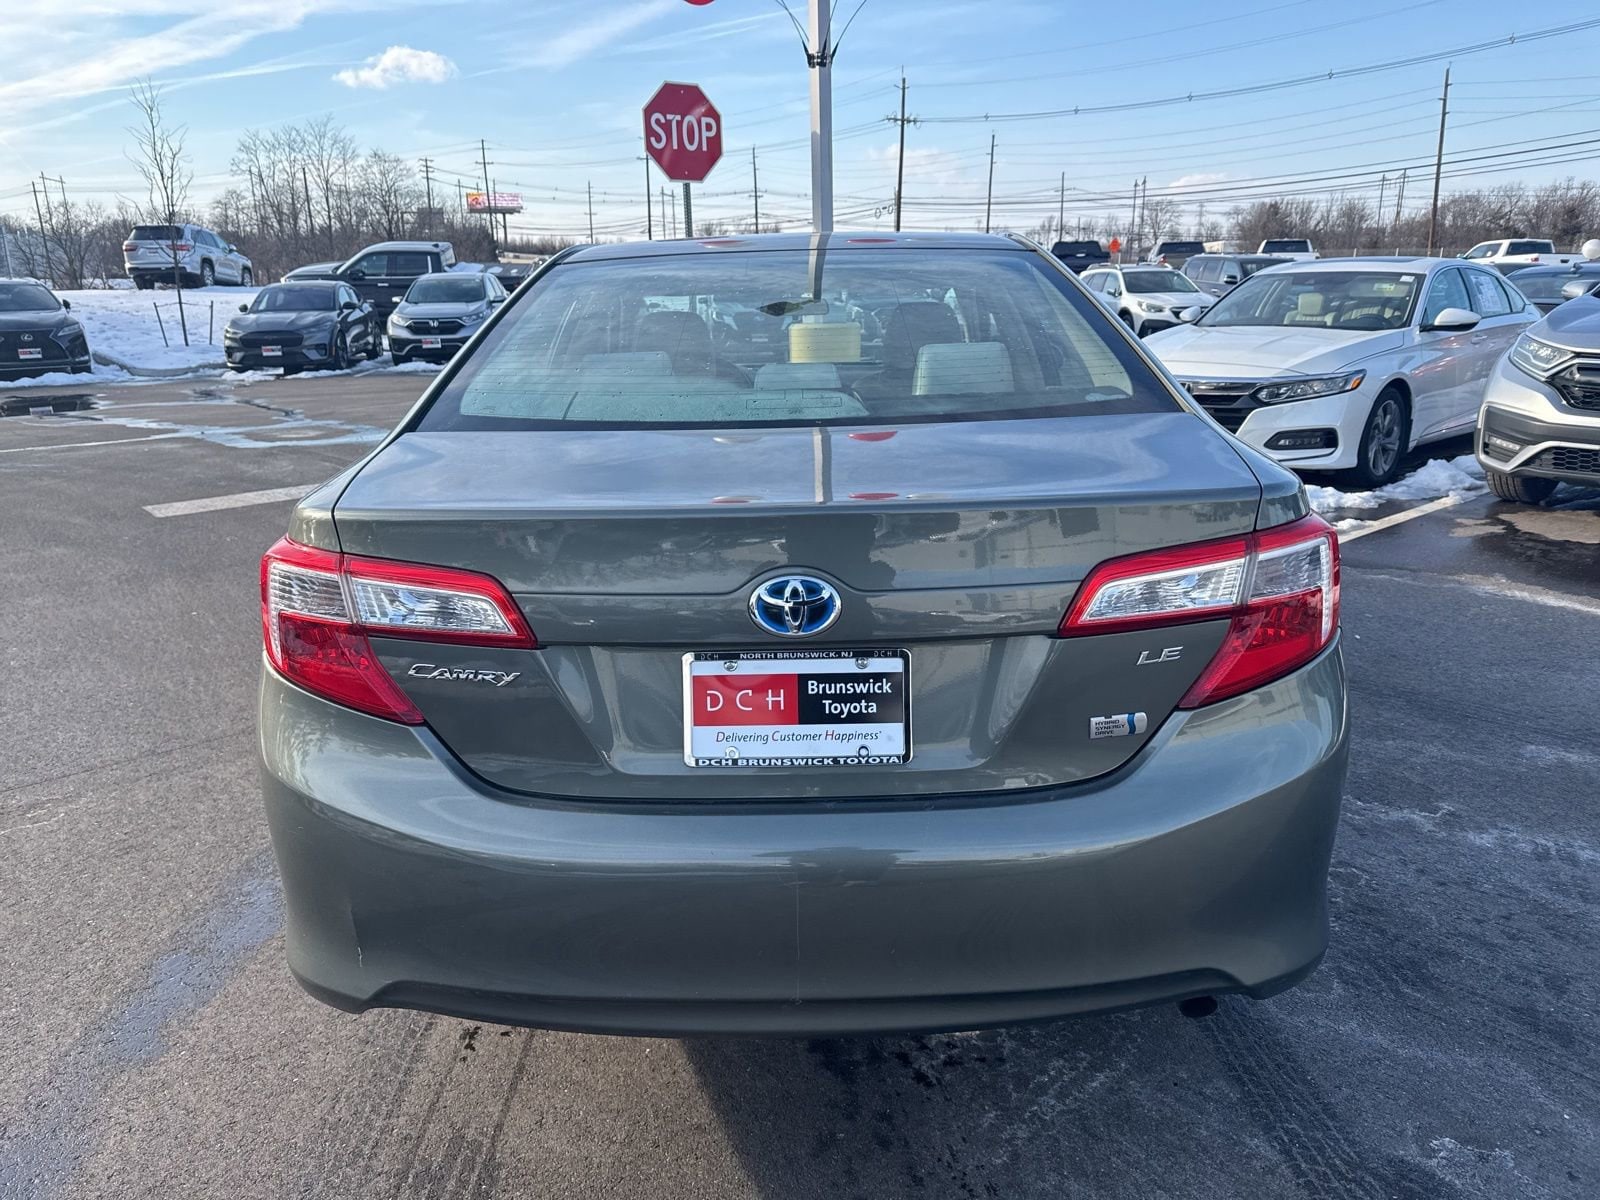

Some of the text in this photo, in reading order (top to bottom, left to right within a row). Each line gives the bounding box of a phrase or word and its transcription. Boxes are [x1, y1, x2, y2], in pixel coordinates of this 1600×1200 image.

[650, 112, 717, 152] STOP
[740, 652, 774, 660] NORTH
[1136, 646, 1184, 666] LE
[407, 663, 521, 687] CAMRY
[807, 678, 893, 695] Brunswick
[822, 699, 877, 718] Toyota
[715, 731, 769, 745] Delivering
[771, 730, 823, 743] Customer
[698, 755, 900, 767] DCH BRUNSWICK TOYOTA
